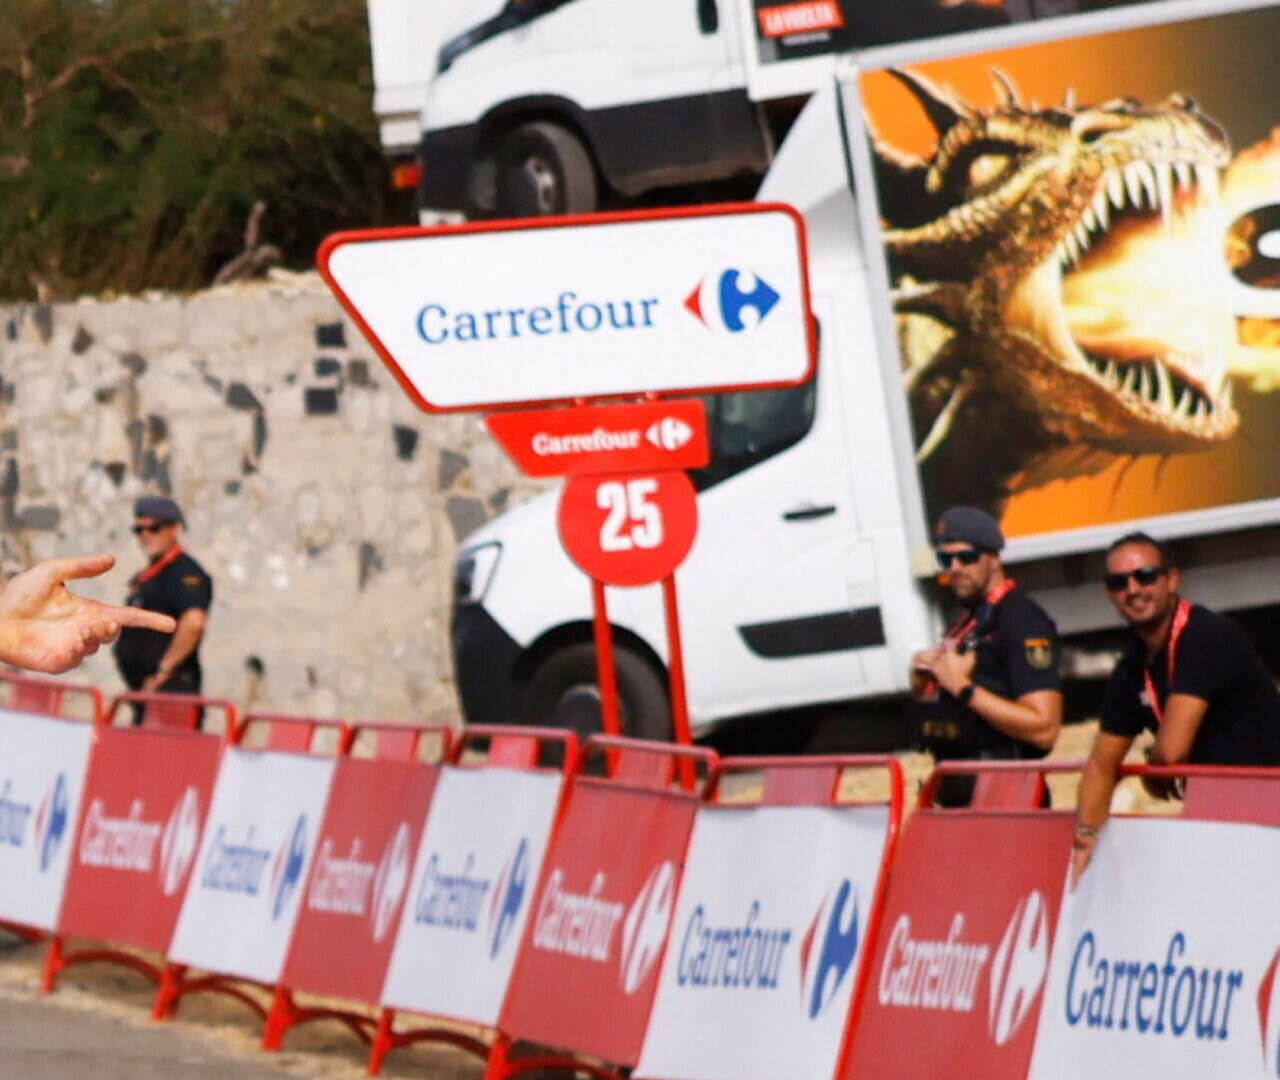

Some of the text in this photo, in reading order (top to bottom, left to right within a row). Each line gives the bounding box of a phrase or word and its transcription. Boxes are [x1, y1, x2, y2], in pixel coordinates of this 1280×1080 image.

[415, 292, 659, 345] Carrefour
[531, 427, 640, 456] Carrefour
[595, 478, 664, 552] 25
[676, 901, 791, 990] Carrefour
[877, 912, 990, 1011] Carrefour
[1064, 929, 1245, 1042] Carrefour
